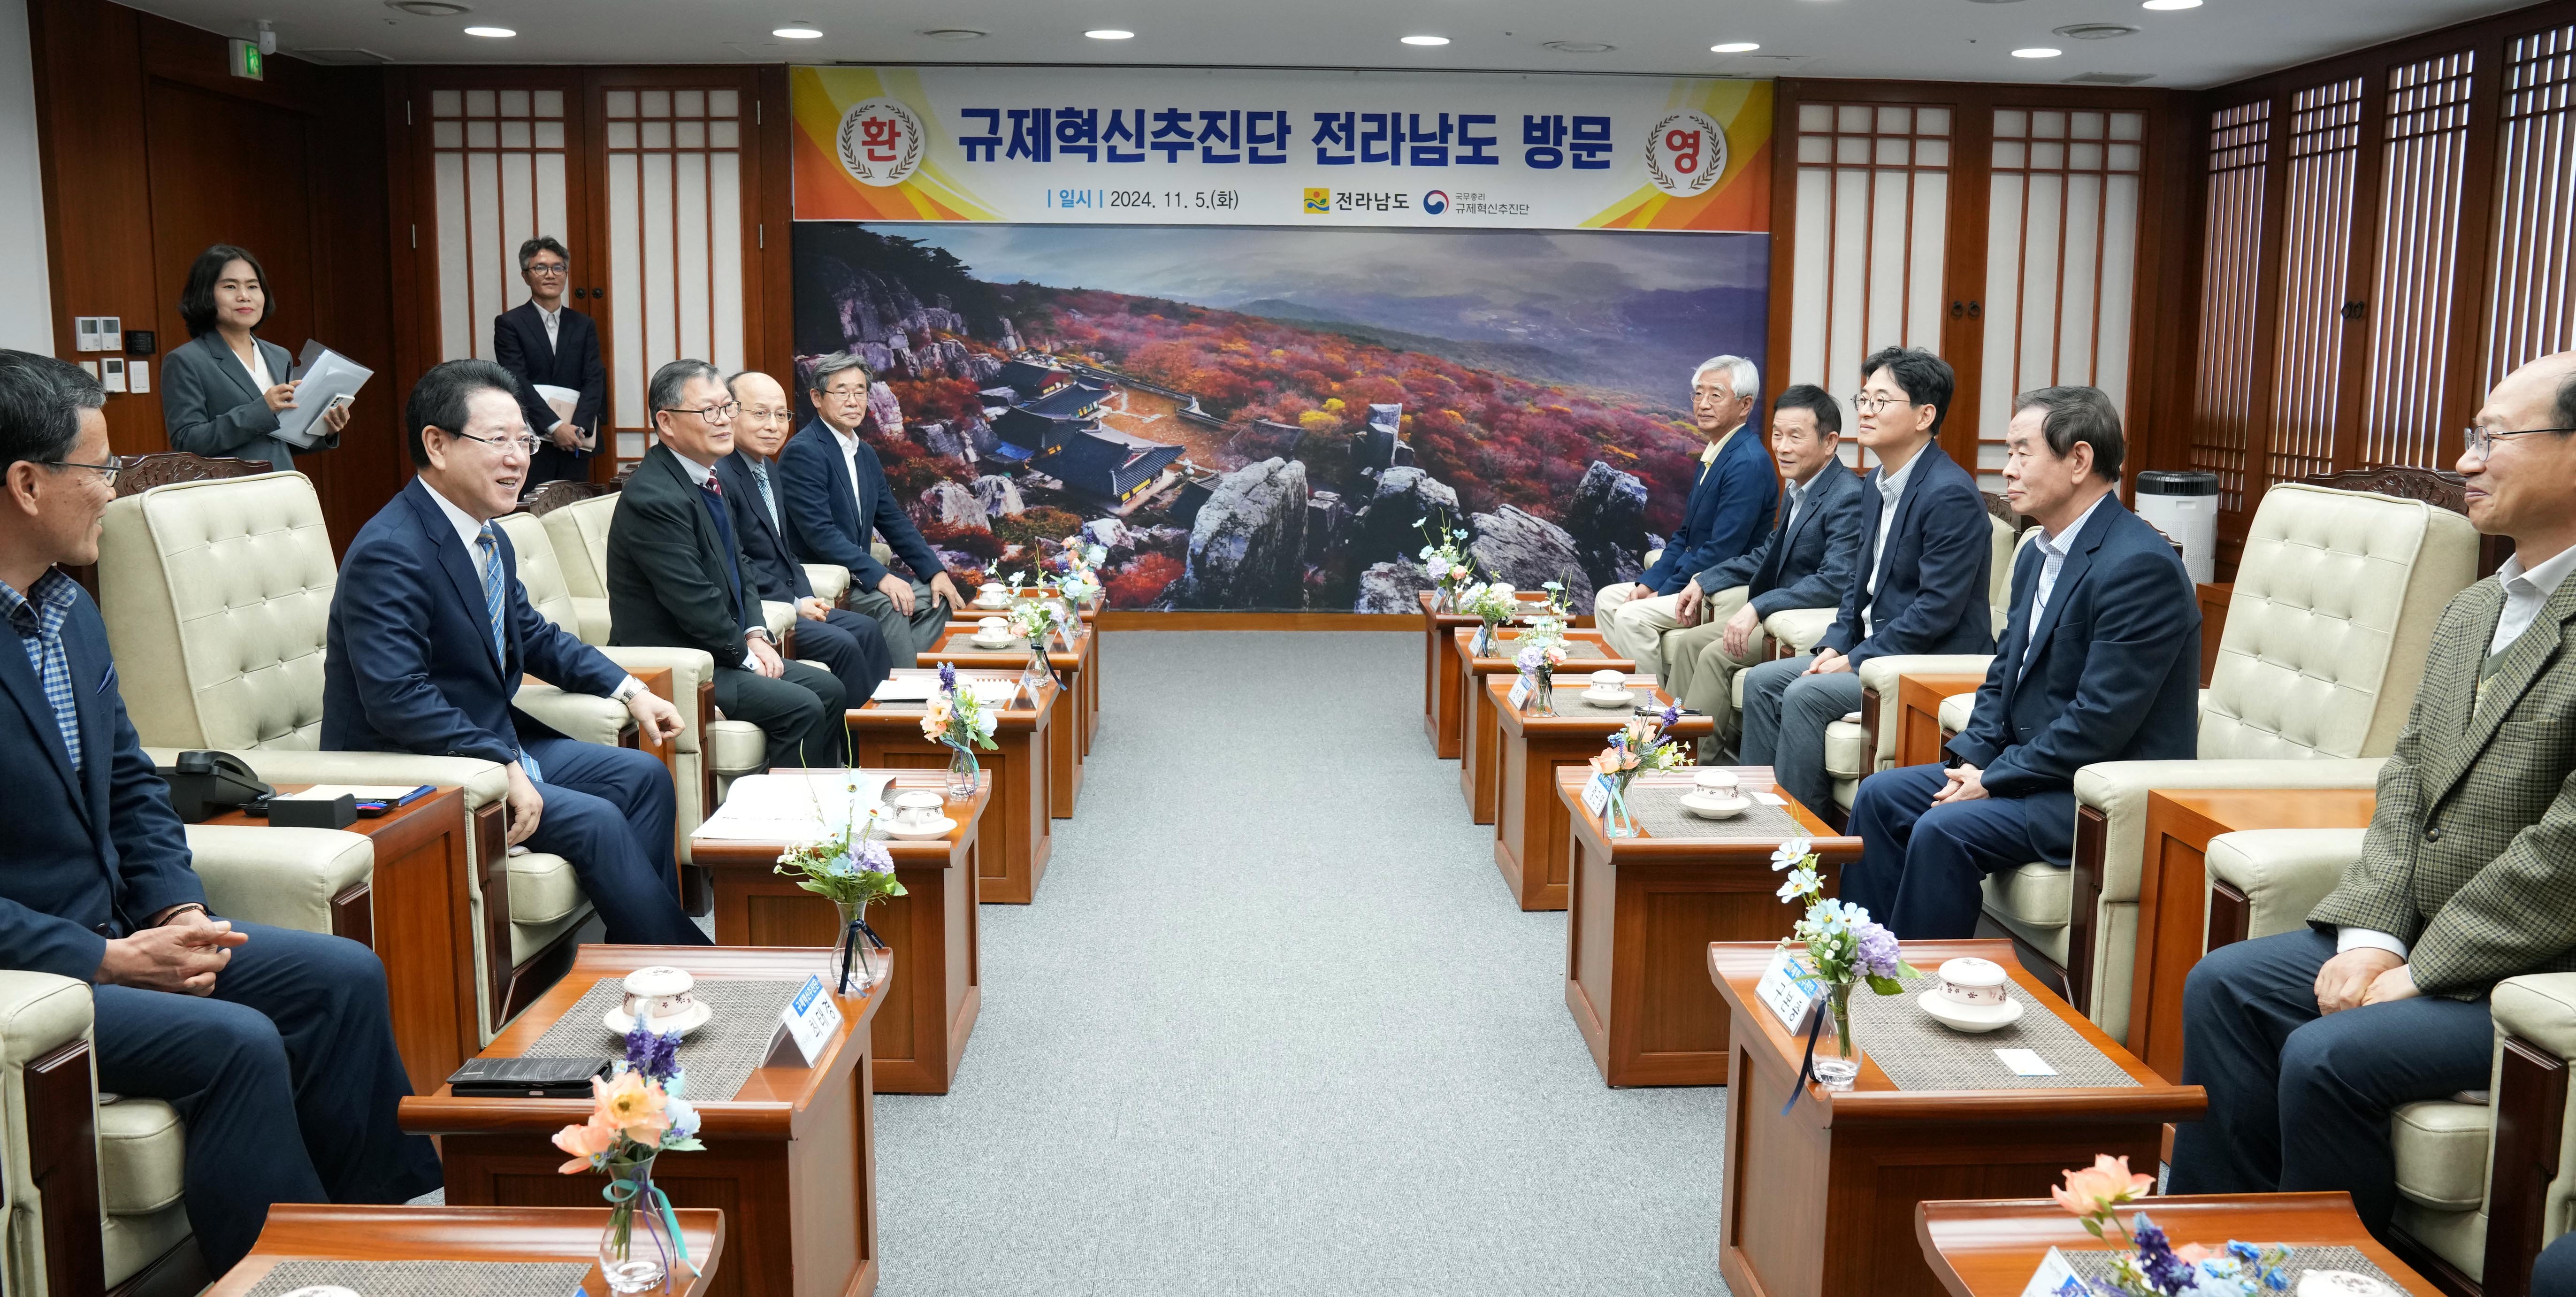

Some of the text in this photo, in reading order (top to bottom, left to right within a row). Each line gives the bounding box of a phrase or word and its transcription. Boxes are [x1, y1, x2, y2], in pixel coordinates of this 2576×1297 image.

[862, 116, 901, 161] 환
[959, 107, 1613, 169] 규제혁신추진단 전라남도 방문
[1666, 130, 1700, 174] 영
[1059, 190, 1238, 210] 일시 2024. 11. 5.(화)
[1336, 192, 1409, 211] 전라남도
[1455, 203, 1529, 215] 규제혁신추진단
[795, 978, 820, 1013] 규제혁신추진단
[1774, 982, 1802, 1021] 구본충
[809, 998, 836, 1038] 최태경
